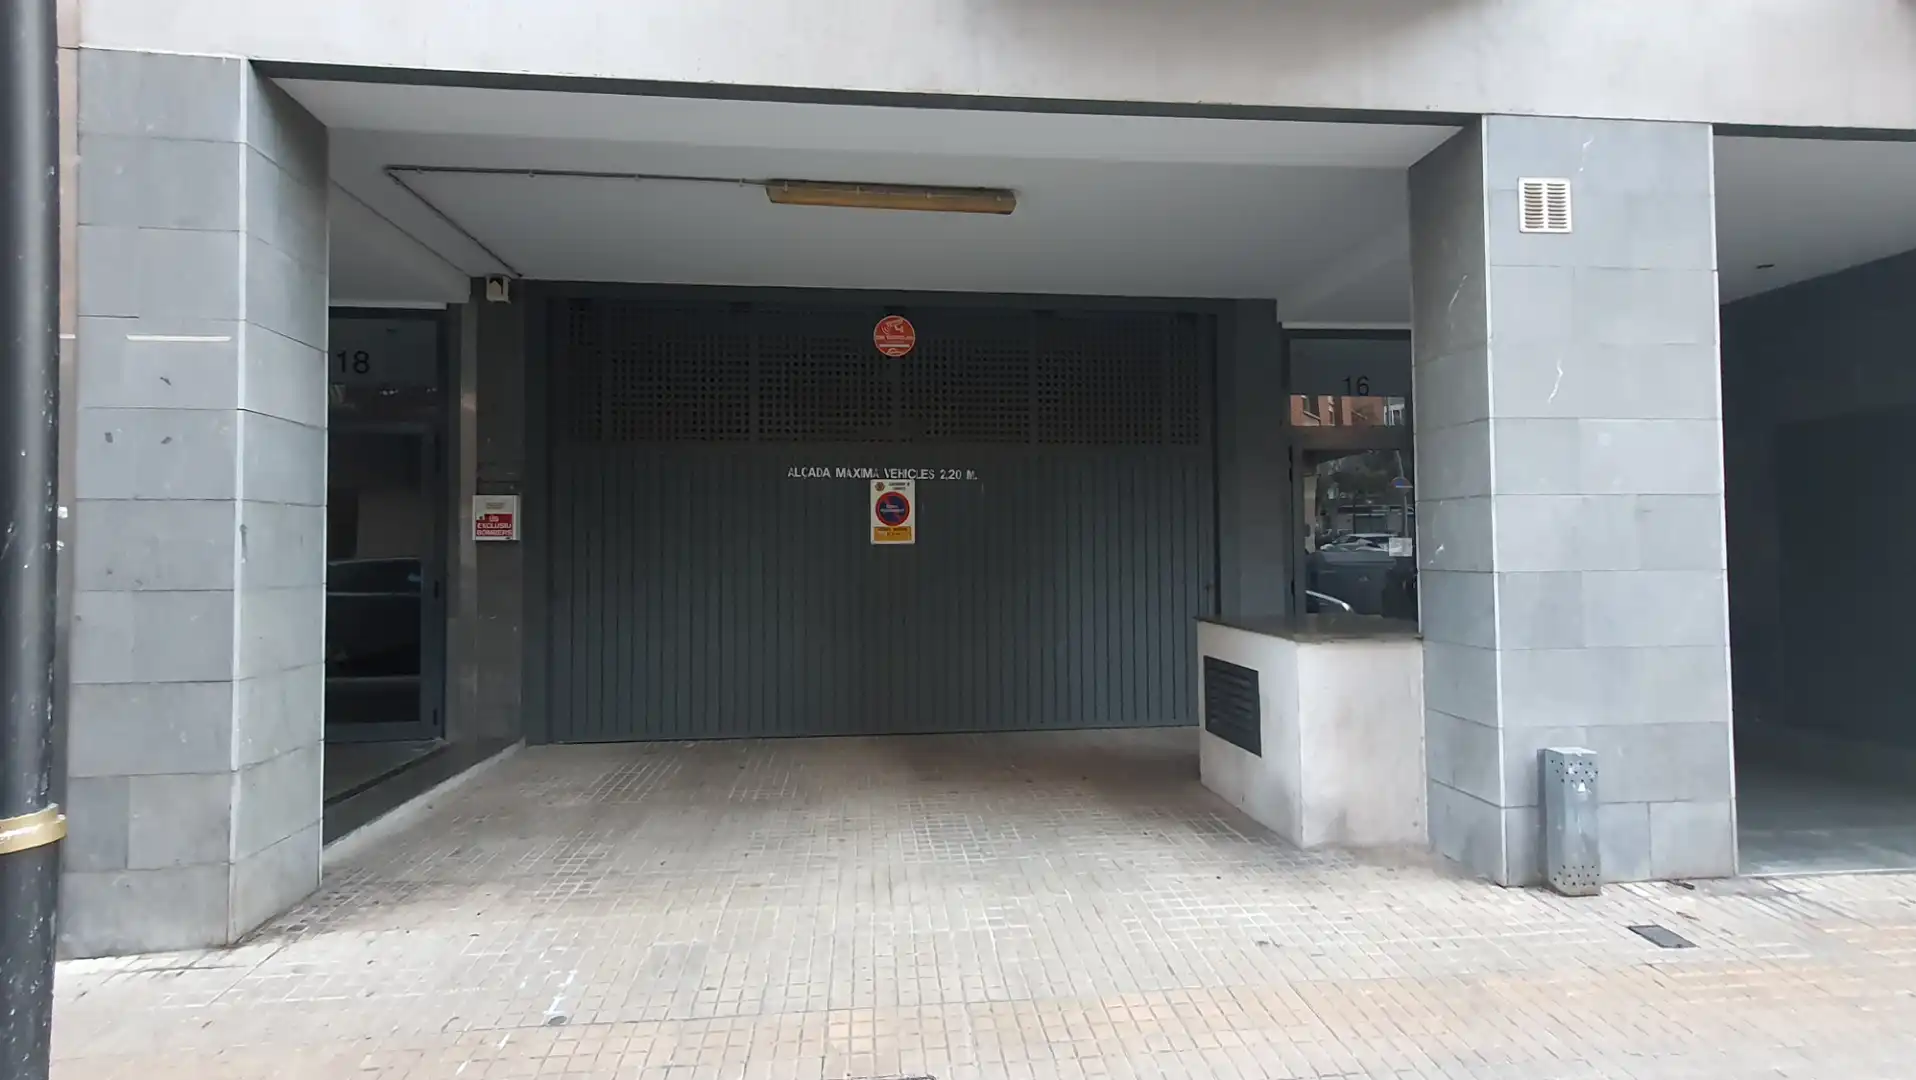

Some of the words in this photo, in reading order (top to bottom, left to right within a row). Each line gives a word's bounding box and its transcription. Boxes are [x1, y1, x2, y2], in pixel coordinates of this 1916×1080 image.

[337, 350, 370, 374] 18
[1341, 374, 1370, 396] 16
[787, 467, 831, 479] ALÇADA
[884, 468, 935, 479] VEHICLES
